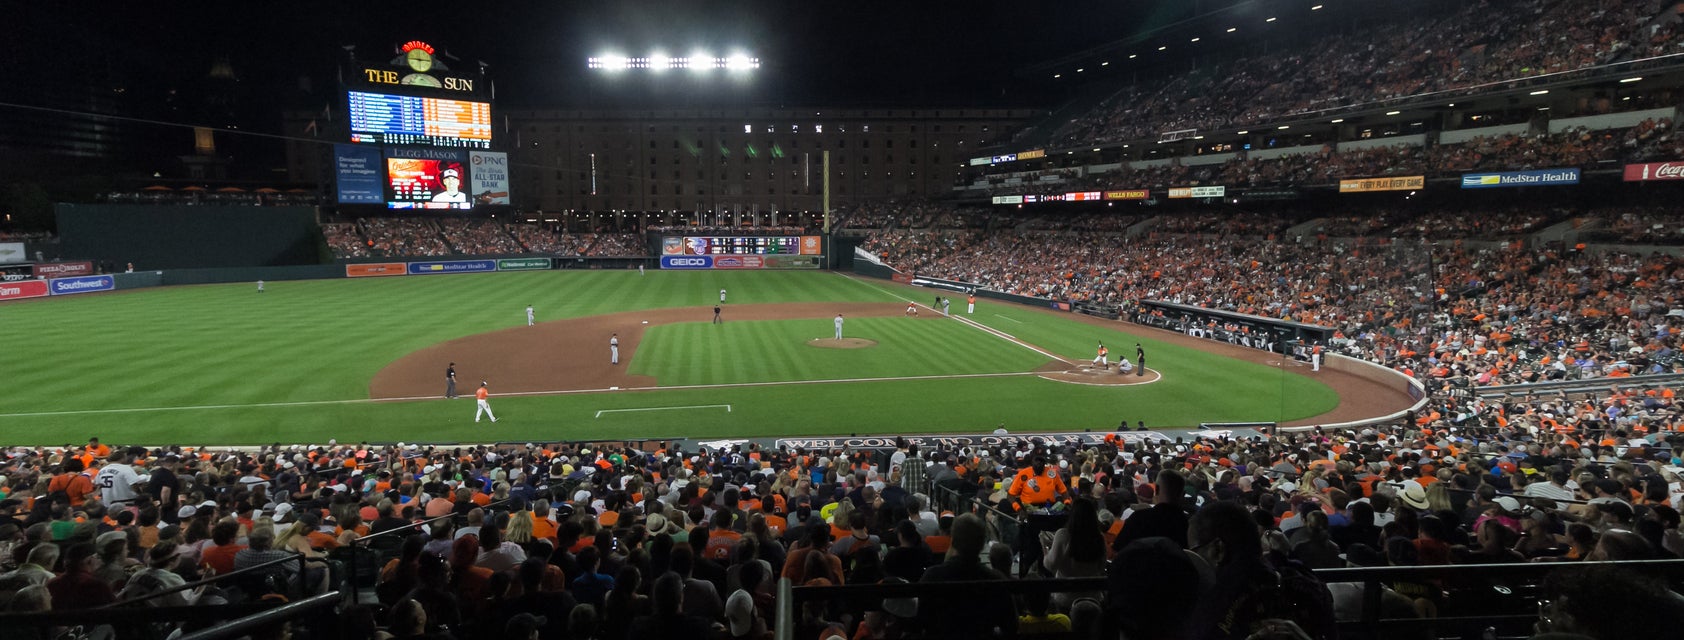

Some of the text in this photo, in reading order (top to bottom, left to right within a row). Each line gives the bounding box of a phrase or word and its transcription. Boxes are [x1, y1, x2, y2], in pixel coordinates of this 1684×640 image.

[402, 41, 435, 55] ORIOLES
[365, 69, 473, 91] THE SUN
[394, 148, 457, 160] LEGG MASON
[484, 156, 506, 165] PNC
[1502, 172, 1577, 183] MedStar Health
[670, 258, 706, 266] GEICO
[58, 280, 103, 290] Southwest
